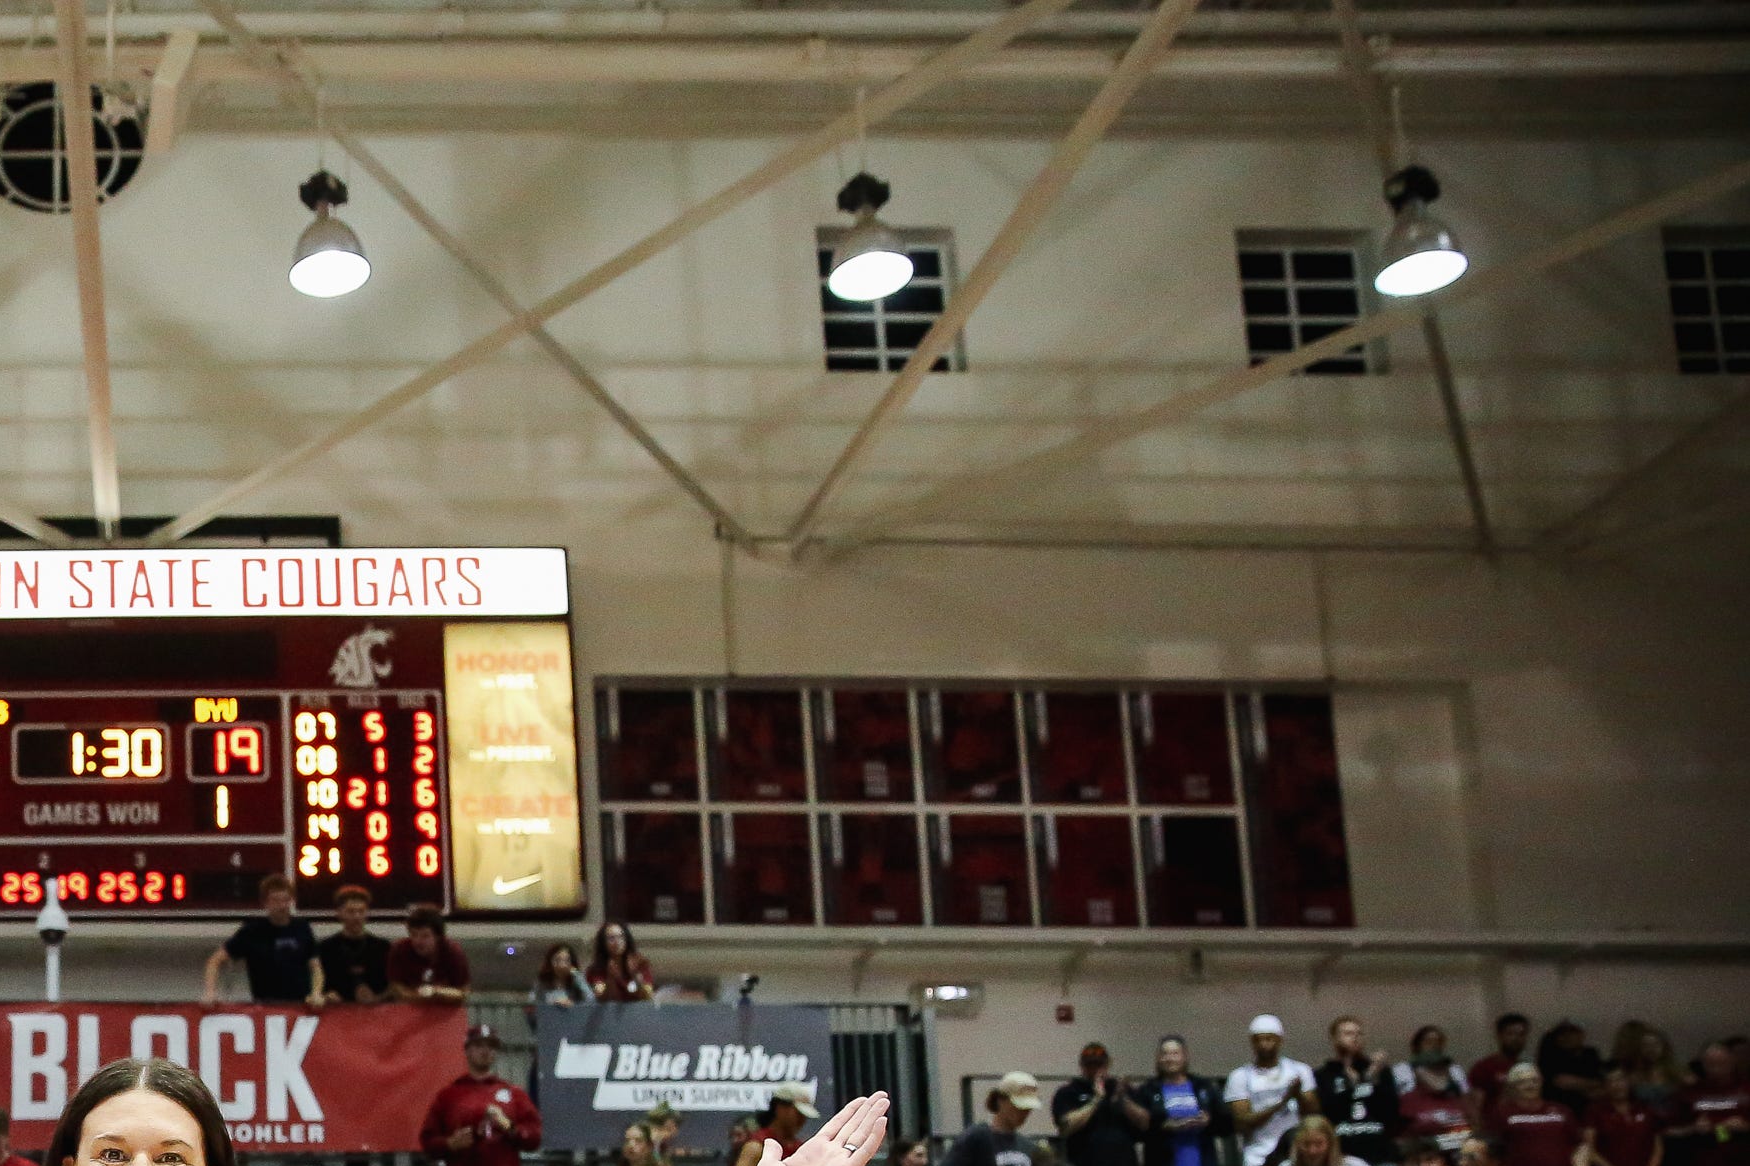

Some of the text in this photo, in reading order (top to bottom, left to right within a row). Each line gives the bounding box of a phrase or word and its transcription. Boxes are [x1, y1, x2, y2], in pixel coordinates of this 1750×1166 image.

[68, 559, 213, 609] STATE
[241, 557, 482, 608] COUGARS
[295, 711, 336, 743] 07
[414, 711, 435, 742] 3
[71, 727, 163, 779] 1:30
[213, 726, 264, 776] 19
[373, 747, 388, 773] 1
[413, 744, 436, 775] 2
[215, 784, 230, 829] 1
[307, 777, 437, 809] 10 21 6
[23, 802, 161, 826] GAMES WON
[307, 810, 438, 842] 14 0 9
[299, 843, 440, 877] 21 6 0
[0, 871, 44, 905] 25
[56, 871, 89, 901] 19
[96, 871, 139, 904] 25
[143, 871, 186, 903] 21
[613, 1042, 809, 1081] Blue Ribbon
